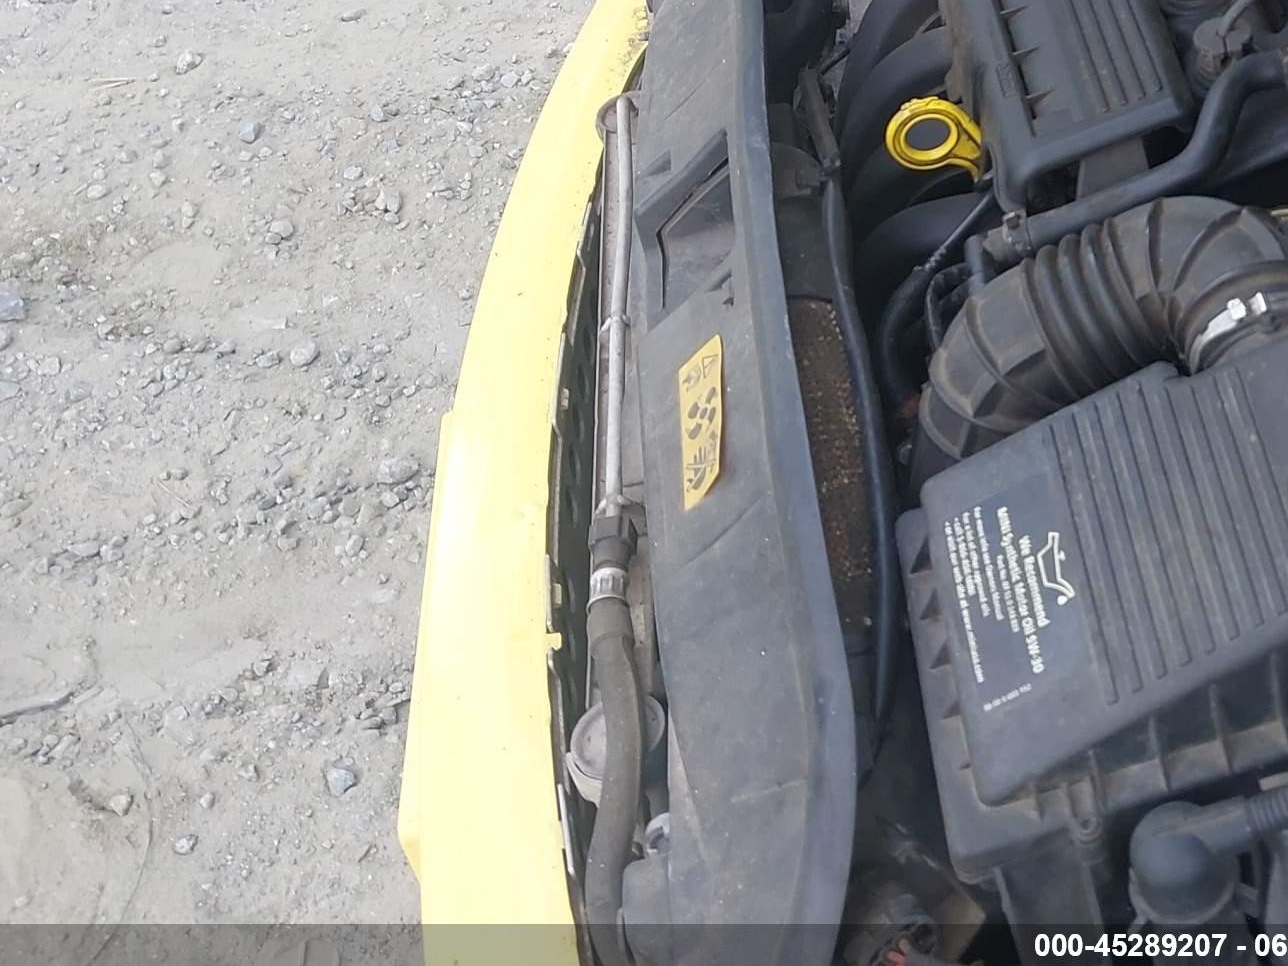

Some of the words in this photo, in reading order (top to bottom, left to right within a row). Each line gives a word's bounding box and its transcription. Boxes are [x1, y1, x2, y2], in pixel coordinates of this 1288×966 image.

[997, 506, 1012, 535] MINI
[1000, 532, 1022, 582] Synthetic
[1018, 535, 1032, 556] We
[991, 591, 1005, 621] Manual
[1014, 583, 1030, 617] Motor
[1023, 555, 1051, 628] Recommend
[1022, 616, 1037, 635] Oil
[1026, 635, 1045, 674] 5W-30
